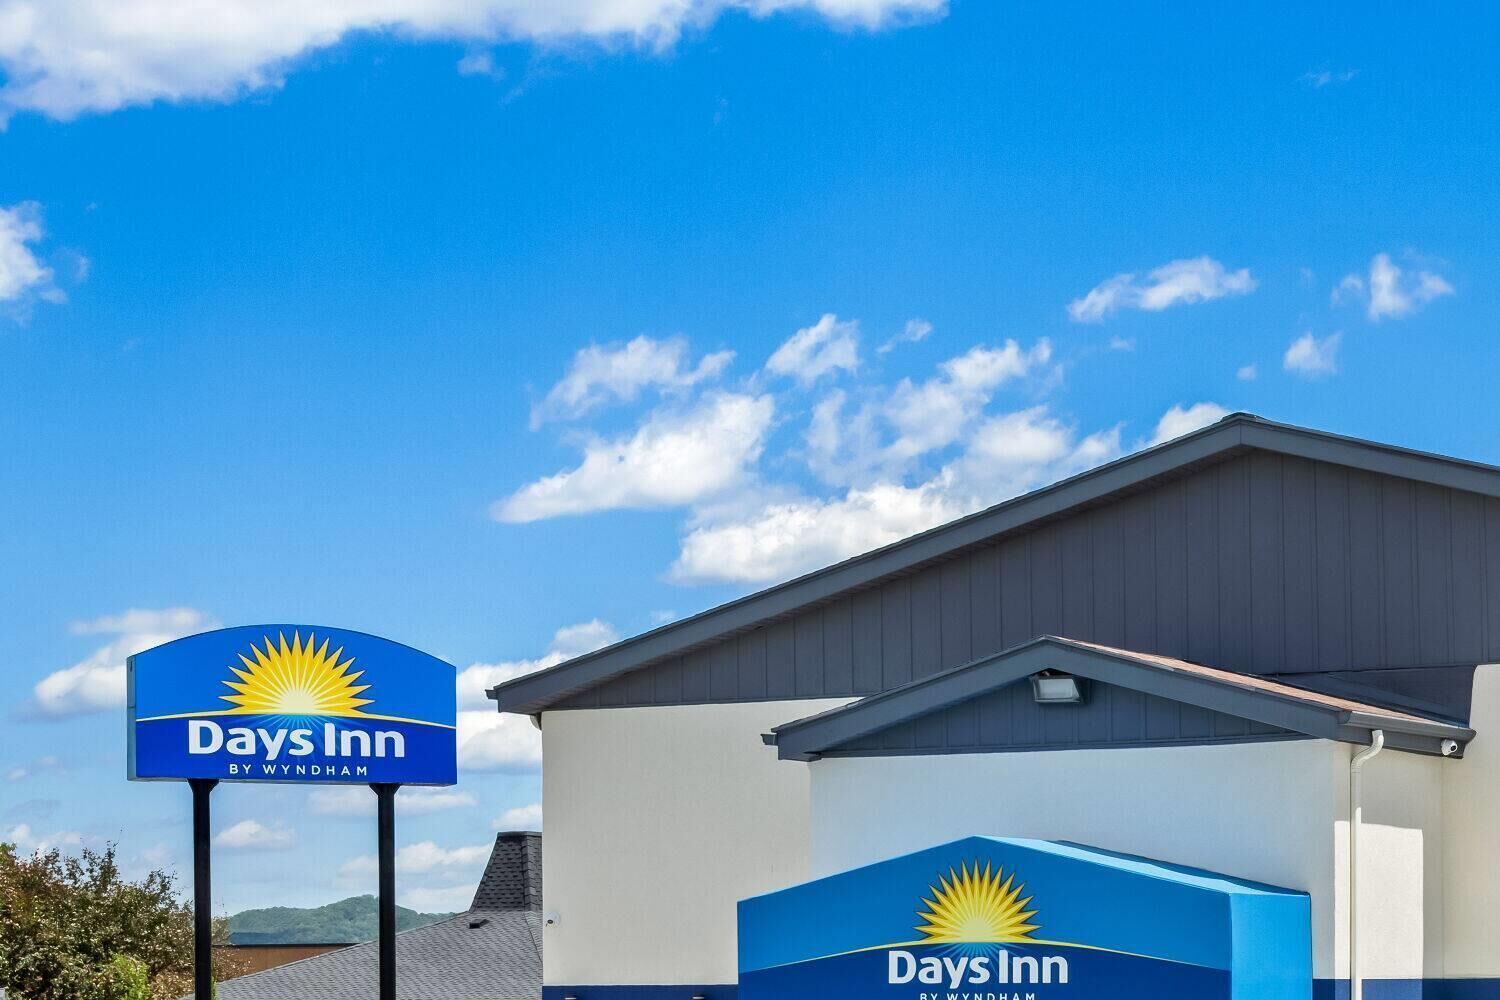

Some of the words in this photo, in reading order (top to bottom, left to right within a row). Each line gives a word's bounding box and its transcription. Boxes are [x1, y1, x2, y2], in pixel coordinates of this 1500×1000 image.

[189, 720, 314, 760] Days
[325, 723, 405, 757] Inn
[229, 764, 251, 775] BY
[262, 764, 367, 776] WYNDHAM
[888, 951, 990, 989] Days
[999, 950, 1068, 984] Inn
